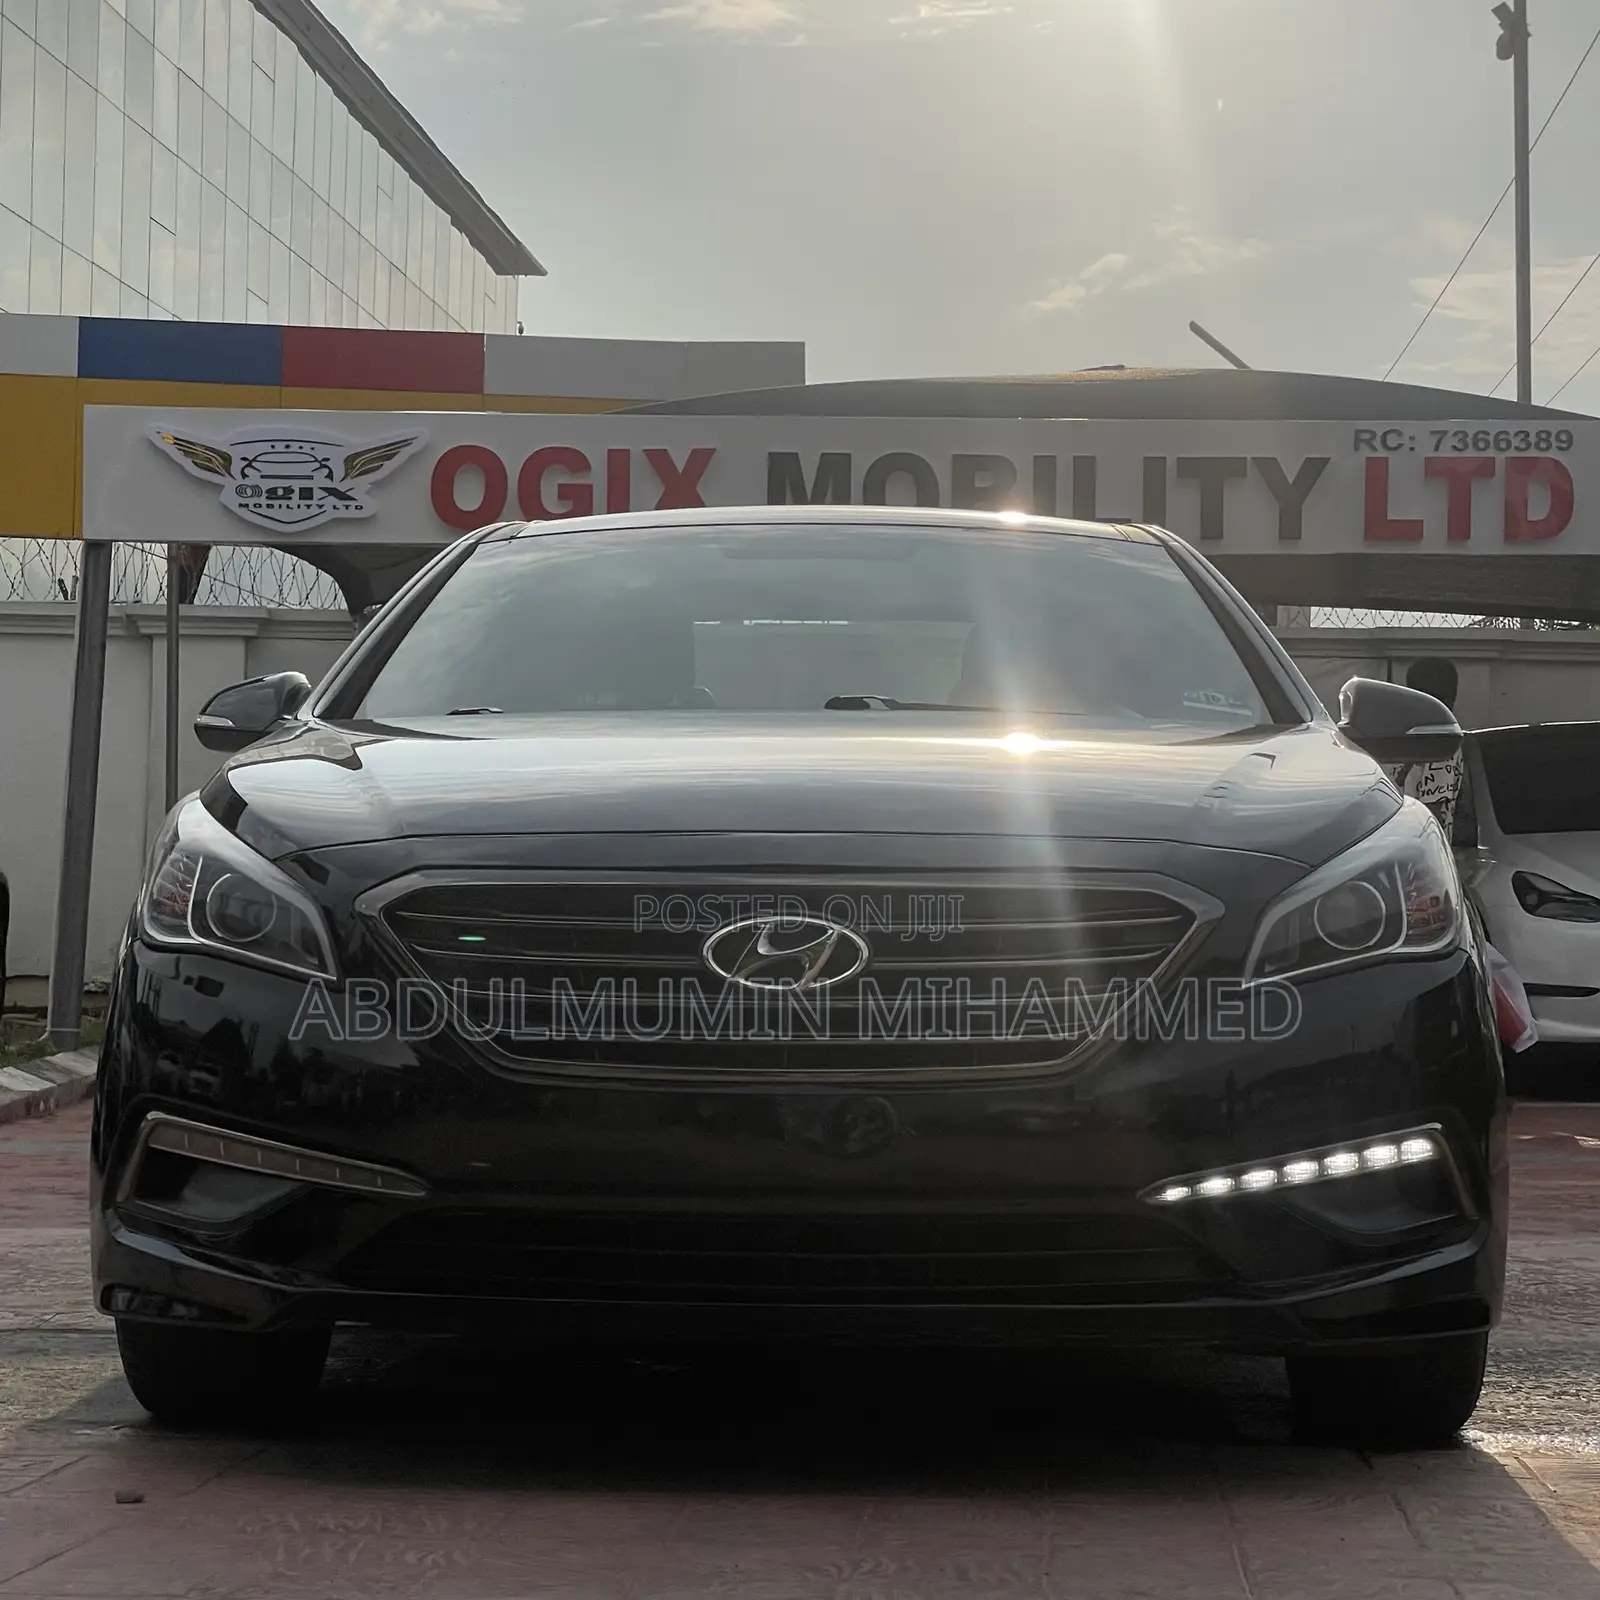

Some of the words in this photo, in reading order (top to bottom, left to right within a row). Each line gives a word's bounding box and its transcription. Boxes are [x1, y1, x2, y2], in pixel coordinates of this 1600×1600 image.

[1353, 429, 1416, 452] RC:
[1429, 429, 1575, 452] 7366389
[430, 444, 718, 532] OGIX
[766, 452, 1332, 540] MOBILITY
[1363, 456, 1575, 541] LTD
[238, 502, 325, 511] MOBILITY
